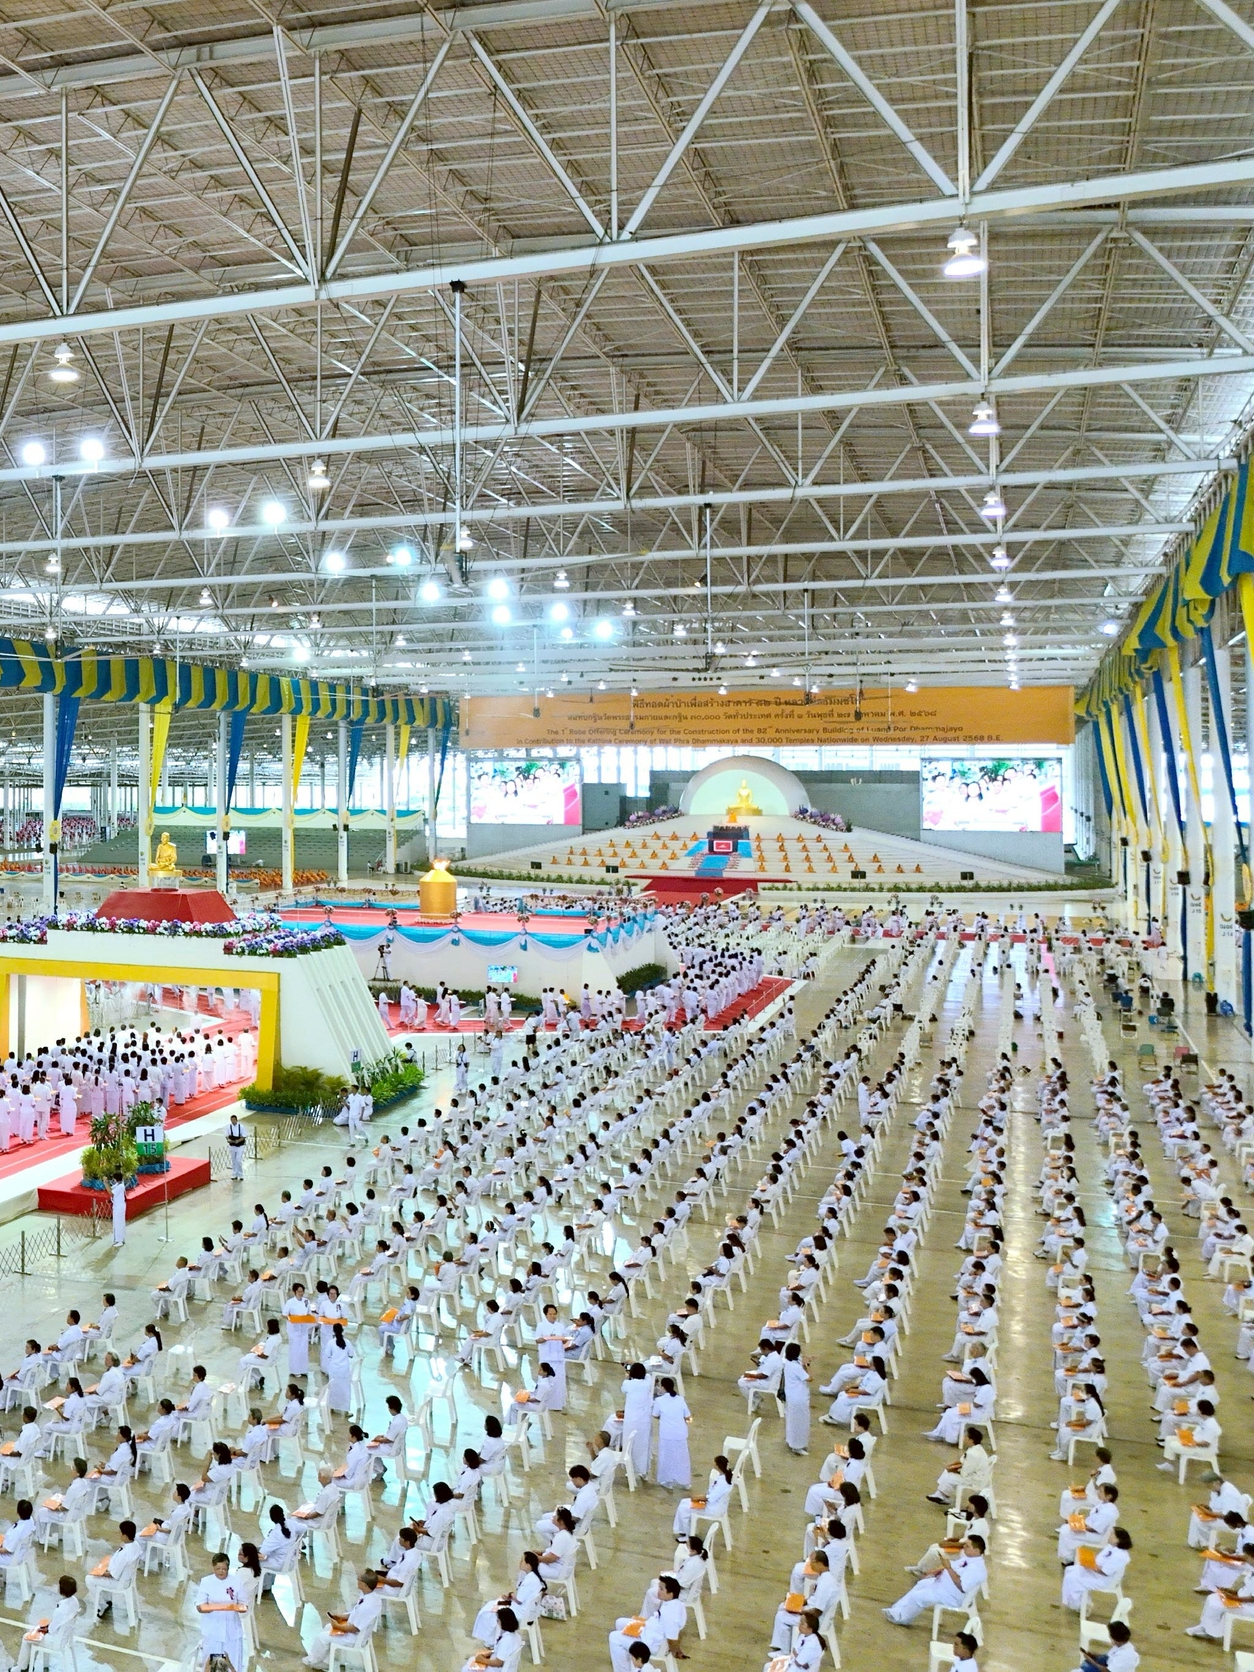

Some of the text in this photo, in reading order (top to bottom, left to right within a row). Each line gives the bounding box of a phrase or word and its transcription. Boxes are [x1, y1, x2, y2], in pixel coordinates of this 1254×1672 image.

[775, 727, 820, 735] Anniversary
[822, 727, 854, 735] Building
[785, 737, 815, 745] Temples
[932, 735, 960, 743] August
[352, 1050, 359, 1062] H
[144, 1129, 155, 1142] H
[143, 1143, 157, 1155] 15
